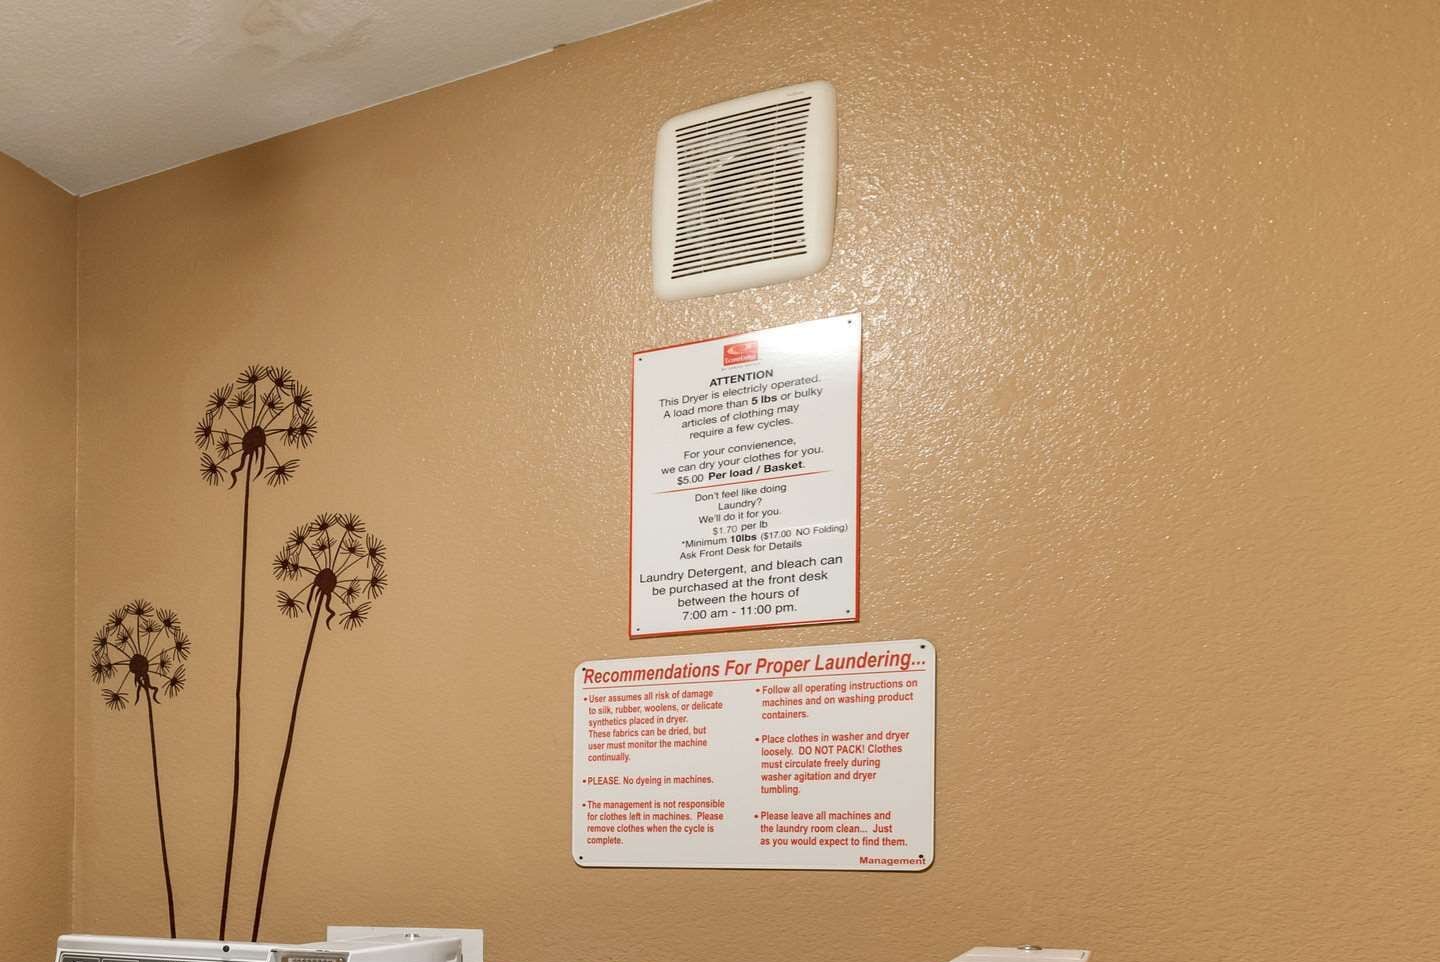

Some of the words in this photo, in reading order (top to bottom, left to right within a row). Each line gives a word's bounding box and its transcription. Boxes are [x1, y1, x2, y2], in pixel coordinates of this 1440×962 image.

[710, 369, 774, 387] ATTENTION
[658, 397, 679, 408] This
[681, 393, 709, 404] Dryer
[711, 390, 720, 399] is
[722, 383, 768, 398] electricly
[770, 375, 822, 391] operated.
[663, 409, 671, 419] A
[673, 406, 695, 417] load
[697, 403, 724, 413] more
[725, 399, 748, 409] than
[751, 396, 758, 406] 5
[760, 394, 778, 404] lbs
[780, 392, 791, 401] or
[794, 387, 823, 399] bulky
[680, 416, 718, 429] articles
[719, 412, 730, 423] of
[732, 407, 774, 421] clothing
[776, 403, 800, 414] may
[689, 427, 724, 439] require
[726, 426, 733, 434] a
[735, 423, 755, 432] few
[756, 417, 793, 431] cycles.
[683, 450, 700, 460] For
[702, 447, 725, 459] your
[727, 439, 796, 454] convienence,
[660, 466, 676, 475] we
[677, 463, 696, 473] can
[698, 460, 715, 471] dry
[717, 457, 740, 469] your
[742, 452, 781, 464] clothes
[783, 448, 799, 458] for
[800, 446, 824, 458] you.
[676, 473, 704, 486] $5.00
[708, 471, 727, 481] Per
[729, 466, 753, 478] load
[694, 491, 719, 502] Don't
[721, 488, 739, 498] feel
[741, 487, 758, 496] like
[759, 484, 787, 494] doing
[718, 496, 762, 511] Laundry?
[698, 513, 721, 524] We'll
[722, 512, 736, 521] do
[737, 511, 744, 520] it
[746, 510, 759, 519] for
[761, 508, 781, 519] you.
[730, 533, 757, 543] 10lbs
[795, 527, 811, 536] NO
[679, 550, 697, 560] Ask
[699, 548, 724, 558] Front
[726, 545, 751, 555] Desk
[752, 543, 766, 552] for
[768, 539, 802, 551] Details
[639, 570, 684, 584] Laundry
[687, 564, 747, 579] Detergent,
[750, 560, 773, 573] and
[776, 556, 817, 570] bleach
[819, 555, 843, 566] can
[651, 586, 666, 596] be
[668, 579, 729, 597] purchased
[731, 578, 743, 589] at
[746, 576, 765, 587] the
[767, 573, 796, 585] front
[798, 569, 828, 582] desk
[677, 595, 726, 607] between
[729, 592, 747, 603] the
[750, 590, 784, 601] hours
[787, 586, 800, 598] of
[682, 609, 707, 621] 7:00
[709, 609, 728, 619] am
[740, 603, 772, 616] 11:00
[775, 603, 797, 615] pm.
[583, 664, 720, 684] Recommendations
[724, 660, 752, 676] For
[755, 657, 811, 677] Proper
[814, 650, 926, 671] Laundering...
[588, 694, 606, 703] User
[607, 694, 642, 702] assumes
[643, 691, 653, 700] all
[654, 690, 670, 700] risk
[671, 689, 680, 699] of
[681, 689, 714, 700] damage
[762, 684, 790, 695] Follow
[792, 683, 803, 693] all
[804, 683, 847, 694] operating
[848, 679, 903, 690] instructions
[905, 679, 918, 688] on
[761, 698, 803, 707] machines
[805, 695, 822, 705] and
[823, 696, 836, 705] on
[837, 694, 876, 705] washing
[877, 691, 914, 704] product
[761, 734, 785, 744] Place
[786, 733, 819, 743] clothes
[820, 733, 829, 742] in
[831, 731, 864, 742] washer
[866, 730, 883, 740] and
[885, 730, 910, 742] dryer
[760, 759, 783, 769] must
[784, 758, 822, 768] circulate
[823, 758, 849, 769] freely
[850, 757, 881, 769] during
[760, 772, 792, 781] washer
[793, 771, 832, 783] agitation
[833, 771, 851, 780] and
[852, 771, 877, 782] dryer
[586, 799, 602, 809] The
[602, 799, 652, 811] management
[653, 799, 661, 809] is
[662, 799, 676, 809] not
[677, 799, 725, 810] responsible
[760, 810, 789, 820] Please
[790, 810, 815, 820] leave
[815, 810, 827, 820] all
[828, 810, 872, 820] machines
[873, 810, 892, 820] and
[759, 837, 771, 846] as
[772, 837, 789, 848] you
[790, 836, 817, 846] would
[818, 837, 849, 848] expect
[850, 837, 860, 846] to
[861, 836, 880, 846] find
[859, 856, 926, 866] Management
